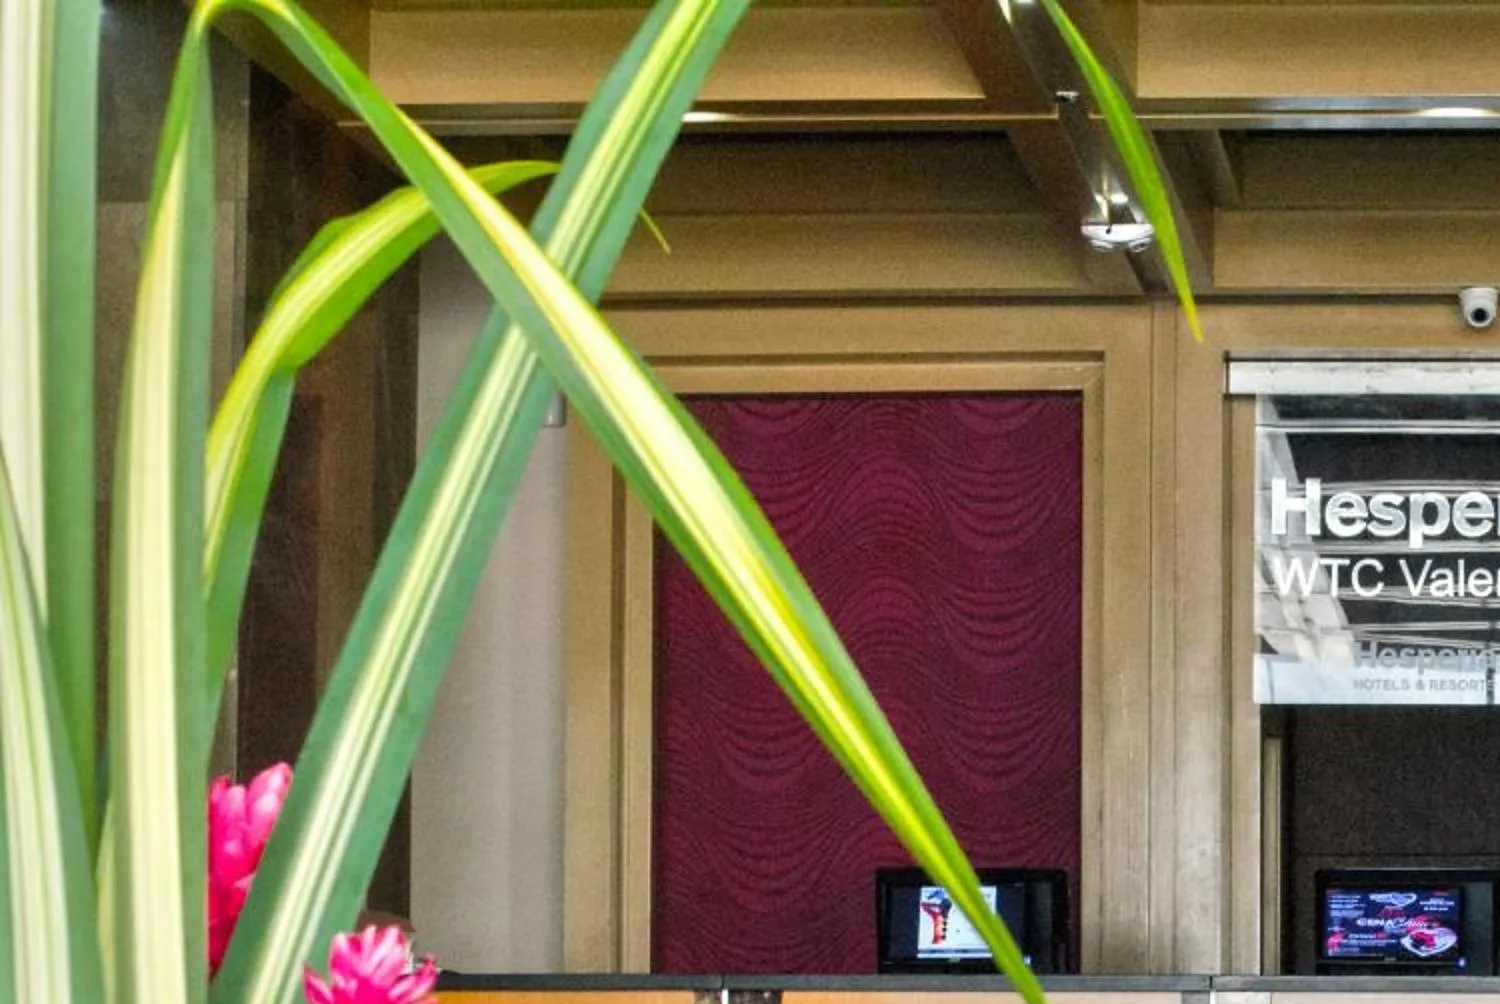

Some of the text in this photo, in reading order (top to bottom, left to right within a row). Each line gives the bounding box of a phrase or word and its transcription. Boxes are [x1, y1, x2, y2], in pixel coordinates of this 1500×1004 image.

[1272, 558, 1384, 597] WTC
[1354, 640, 1496, 675] Hesperia
[1354, 679, 1410, 691] HOTELS
[1415, 679, 1426, 691] &
